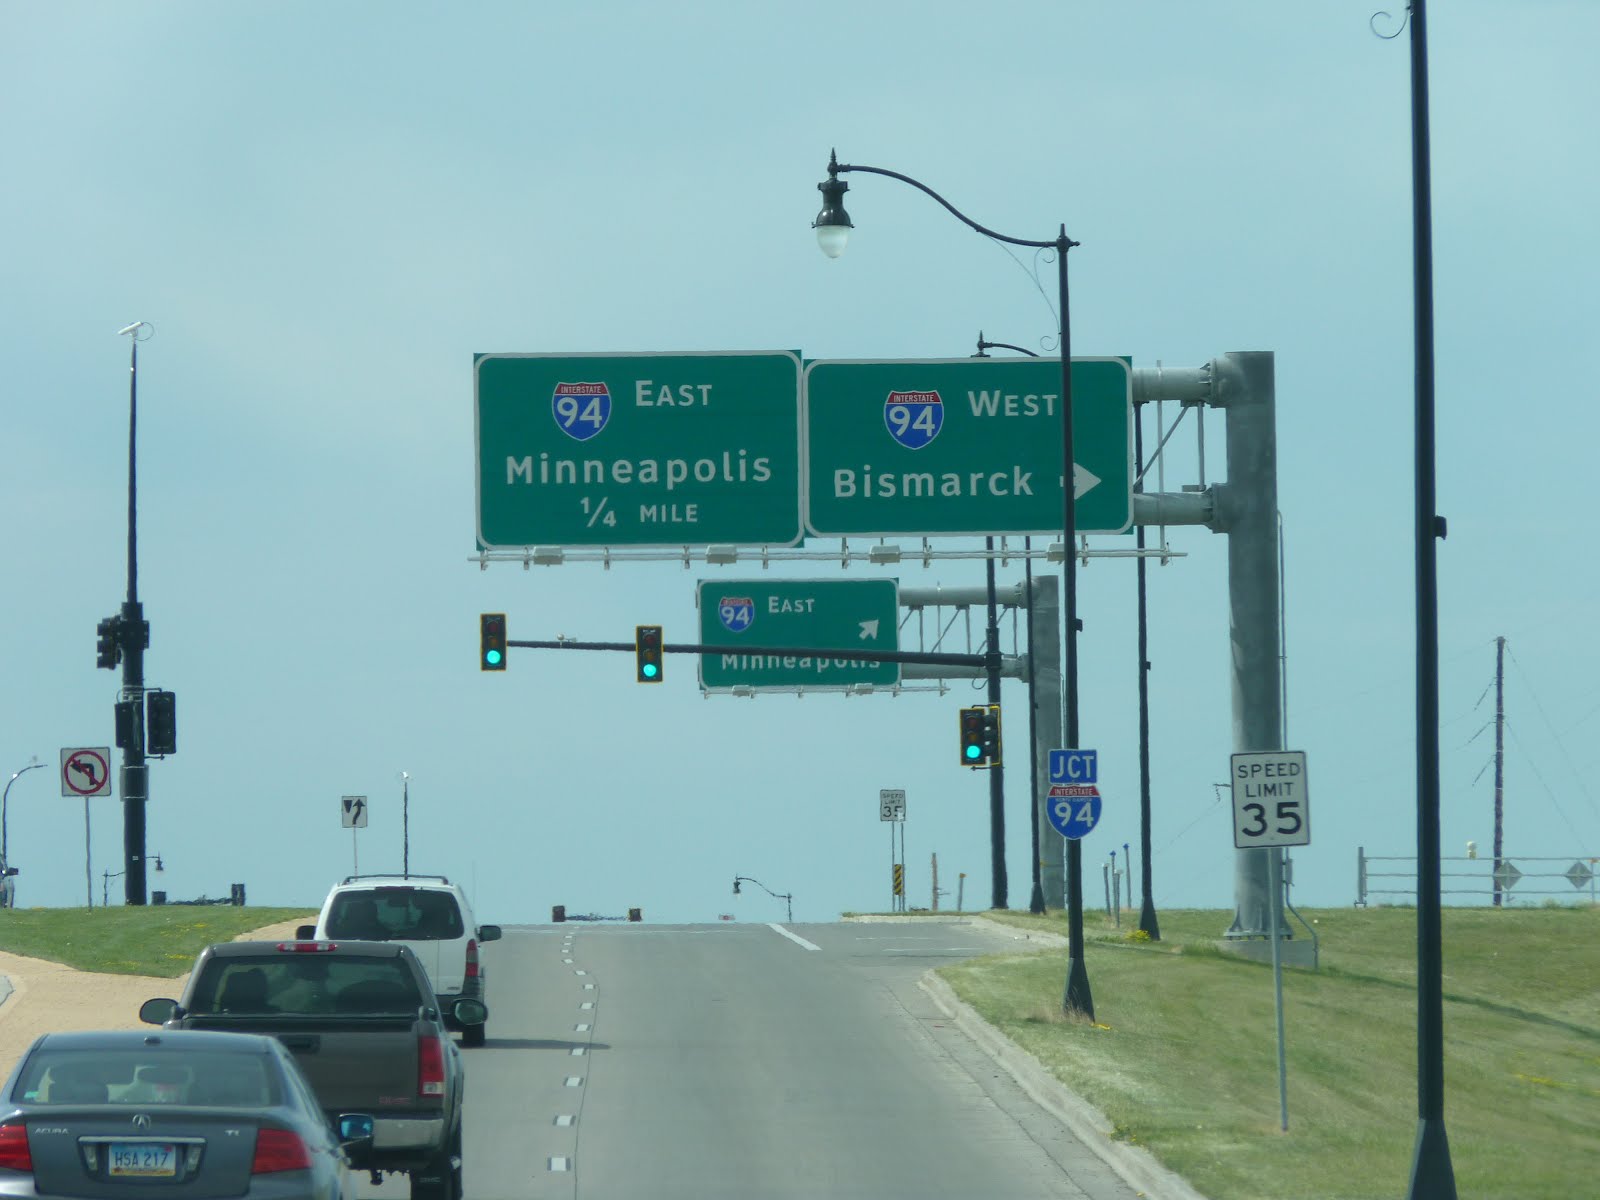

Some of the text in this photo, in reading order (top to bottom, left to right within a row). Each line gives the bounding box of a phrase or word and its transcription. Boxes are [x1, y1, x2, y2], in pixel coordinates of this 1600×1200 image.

[560, 385, 602, 394] INTERSTATE
[635, 379, 713, 407] EAST
[893, 394, 935, 403] INTERSTATE
[557, 396, 603, 429] 94
[967, 389, 1058, 417] WEST
[889, 405, 936, 437] 94
[506, 448, 772, 491] Minneapolis
[833, 464, 1034, 498] Bismarck
[639, 503, 699, 523] MILE
[721, 606, 750, 625] 94
[767, 596, 815, 614] EAST
[1052, 755, 1095, 779] JCT
[1237, 762, 1301, 779] SPEED
[1054, 788, 1093, 796] INTERSTATE
[1245, 782, 1294, 798] LIMIT
[1054, 801, 1095, 828] 94
[1241, 801, 1302, 837] 35
[115, 1151, 169, 1167] HSA 217
